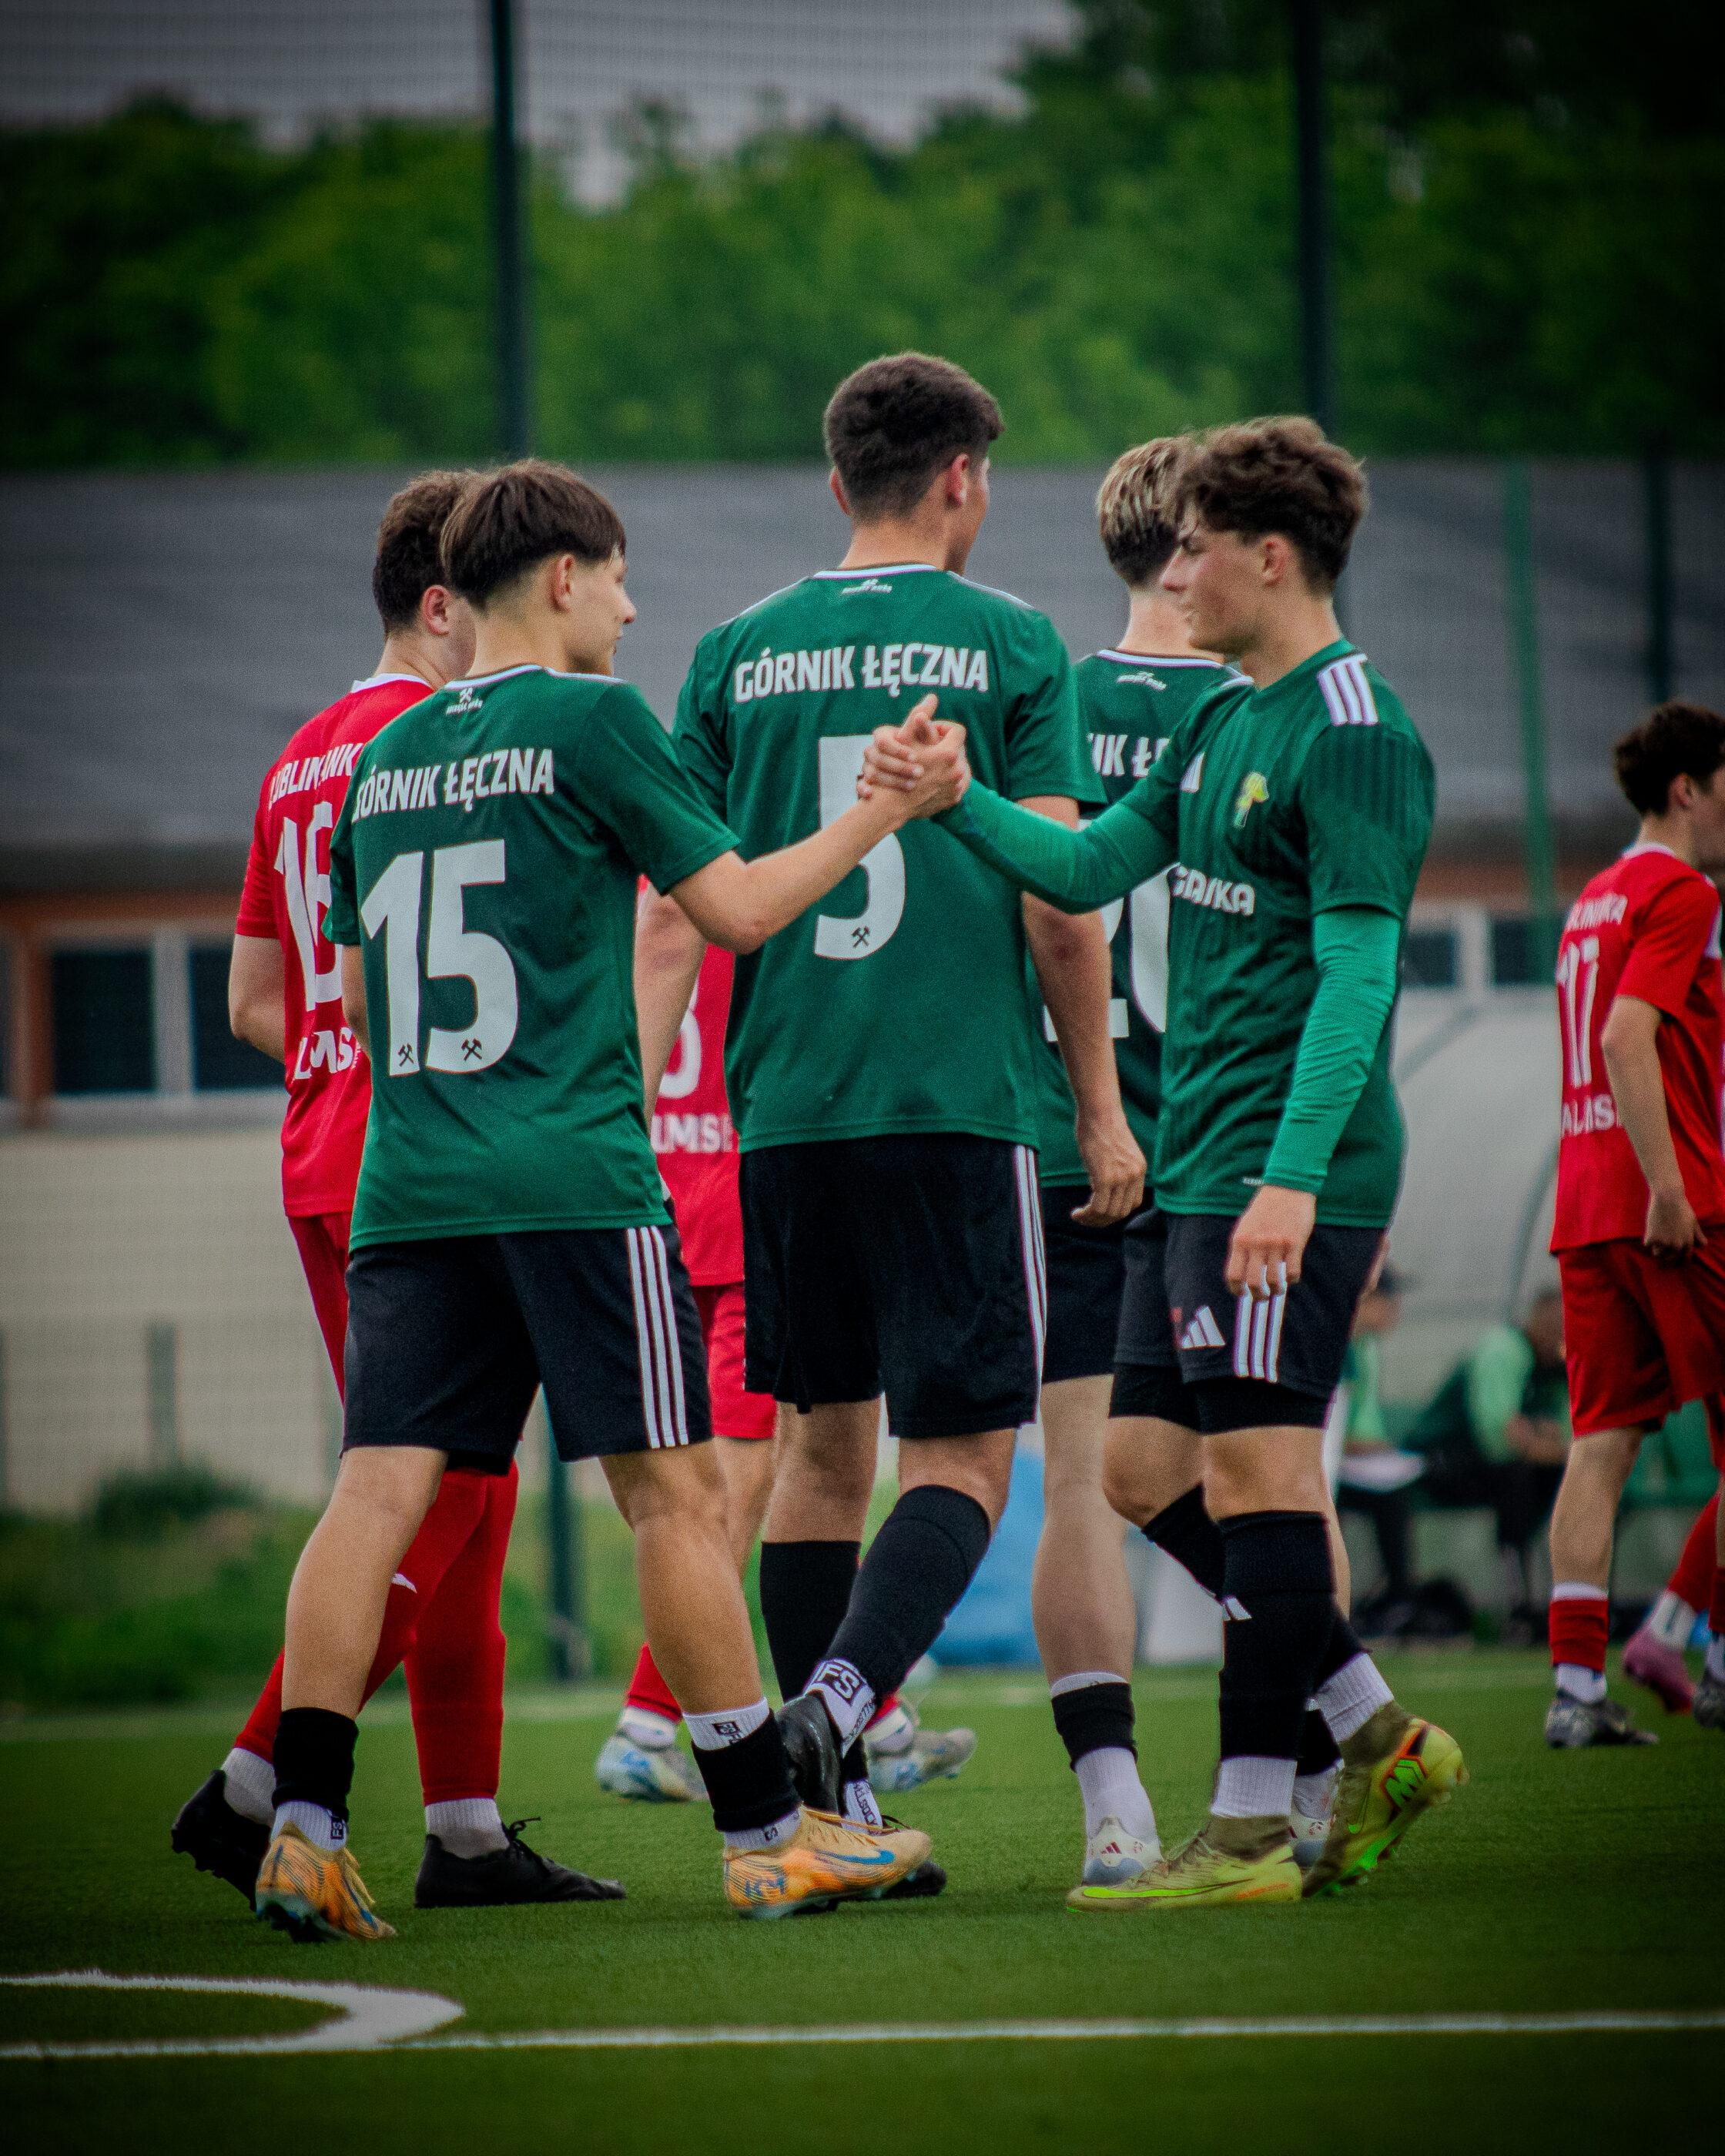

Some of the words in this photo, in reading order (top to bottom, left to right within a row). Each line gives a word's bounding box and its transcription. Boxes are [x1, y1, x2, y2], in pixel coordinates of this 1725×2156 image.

[734, 647, 856, 703] GÓRNIK
[862, 641, 989, 698] ŁĘCZNA
[444, 747, 554, 812] ŁĘCZNA
[360, 839, 518, 1076] 15
[816, 1662, 860, 1699] FS
